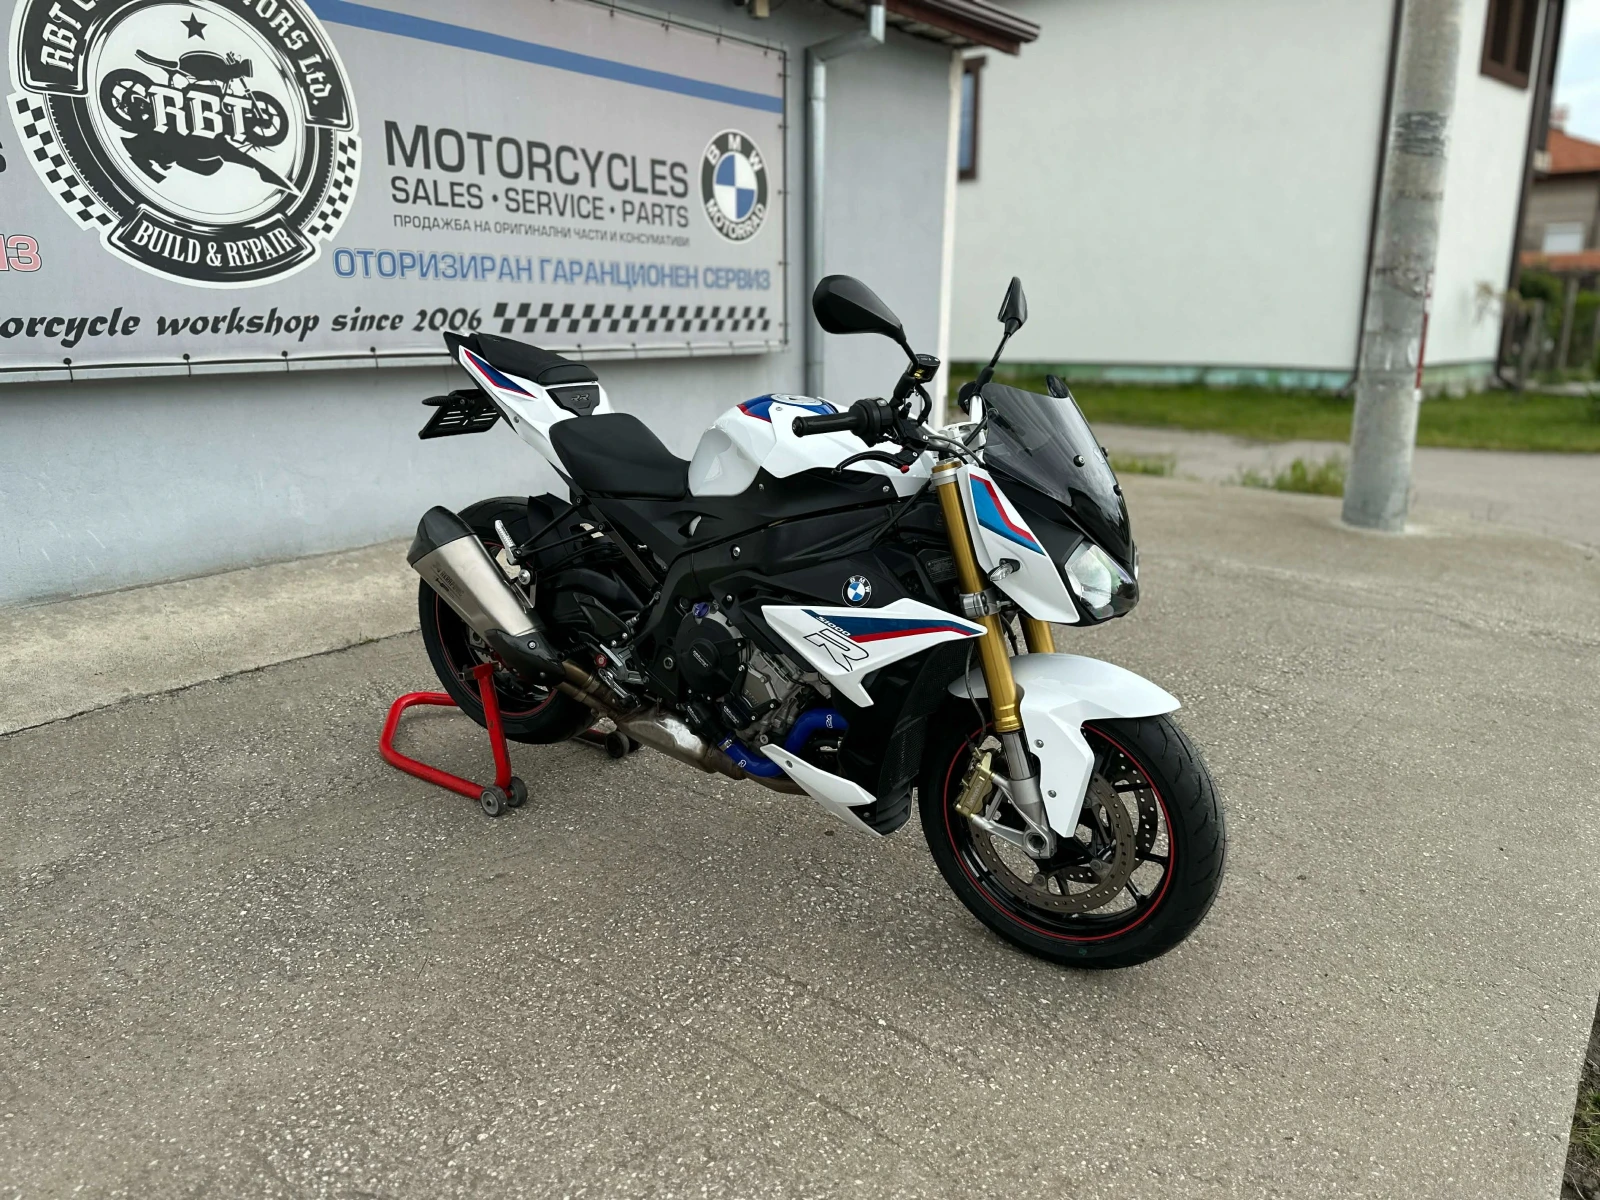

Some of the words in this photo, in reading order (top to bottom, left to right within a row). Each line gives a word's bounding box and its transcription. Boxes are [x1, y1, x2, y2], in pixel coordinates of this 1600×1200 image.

[40, 1, 82, 72] RBT
[243, 0, 309, 50] ORS
[298, 53, 332, 106] Ltd.
[147, 84, 253, 143] RBT
[384, 119, 689, 199] MOTORCYCLES
[706, 133, 763, 172] BMW
[390, 175, 484, 210] SALES
[504, 187, 605, 221] SERVICE
[621, 200, 690, 228] PARTS
[706, 198, 765, 239] MOTORRAD
[131, 219, 200, 264] BUILD
[206, 241, 223, 267] &
[223, 227, 297, 267] REPAIR
[393, 214, 471, 233] ПРОДАЖБА
[474, 220, 492, 233] НА
[494, 221, 572, 239] ОРИГИНАЛНИ
[573, 228, 608, 242] ЧАСТИ
[610, 230, 618, 242] И
[619, 232, 690, 247] КОНСУМАТИВИ
[333, 248, 534, 283] ОТОРИЗИРАН
[537, 255, 700, 292] ГАРАНЦИОНЕН
[702, 264, 772, 292] СЕРВИЗ
[0, 307, 141, 348] orcycle
[157, 306, 320, 342] workshop
[331, 306, 404, 332] since
[412, 307, 482, 332] 2006
[803, 628, 870, 672] R
